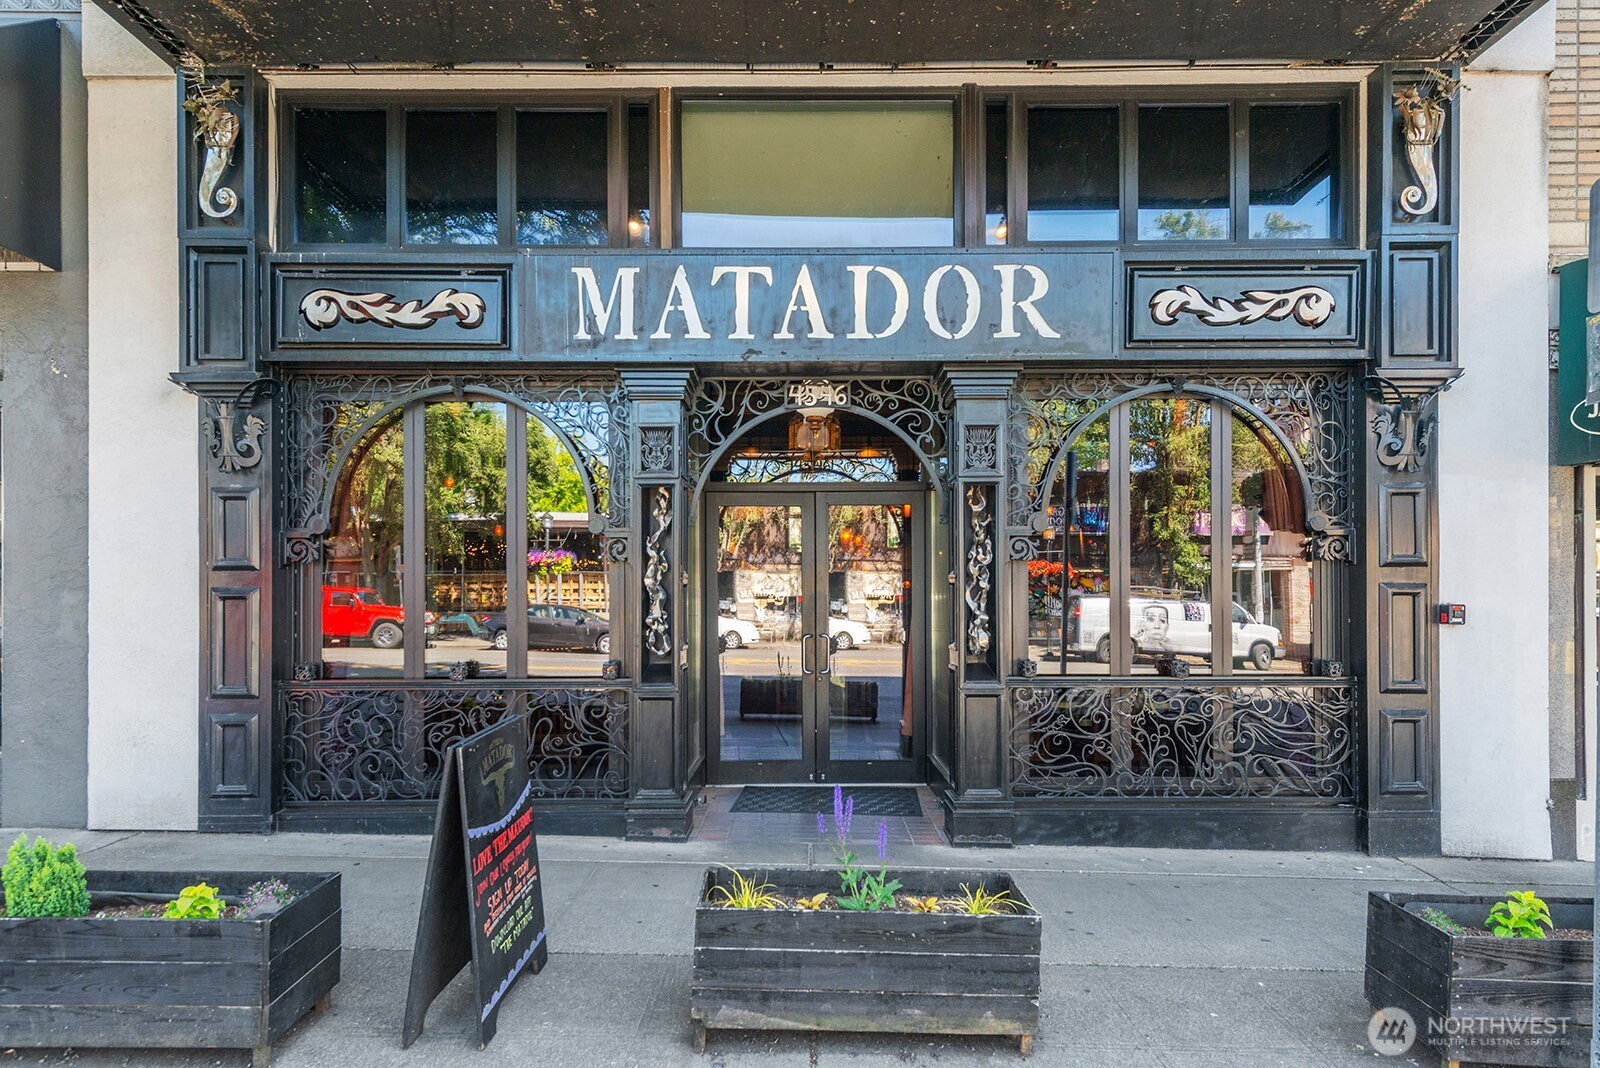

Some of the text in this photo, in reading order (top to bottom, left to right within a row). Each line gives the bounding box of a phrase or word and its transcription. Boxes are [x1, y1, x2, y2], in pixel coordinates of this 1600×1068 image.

[571, 264, 1061, 340] MATADOR
[788, 384, 847, 406] 4546
[472, 845, 493, 877] LOVE
[492, 829, 509, 857] THE
[488, 887, 503, 916] SIGN
[504, 876, 512, 894] UP
